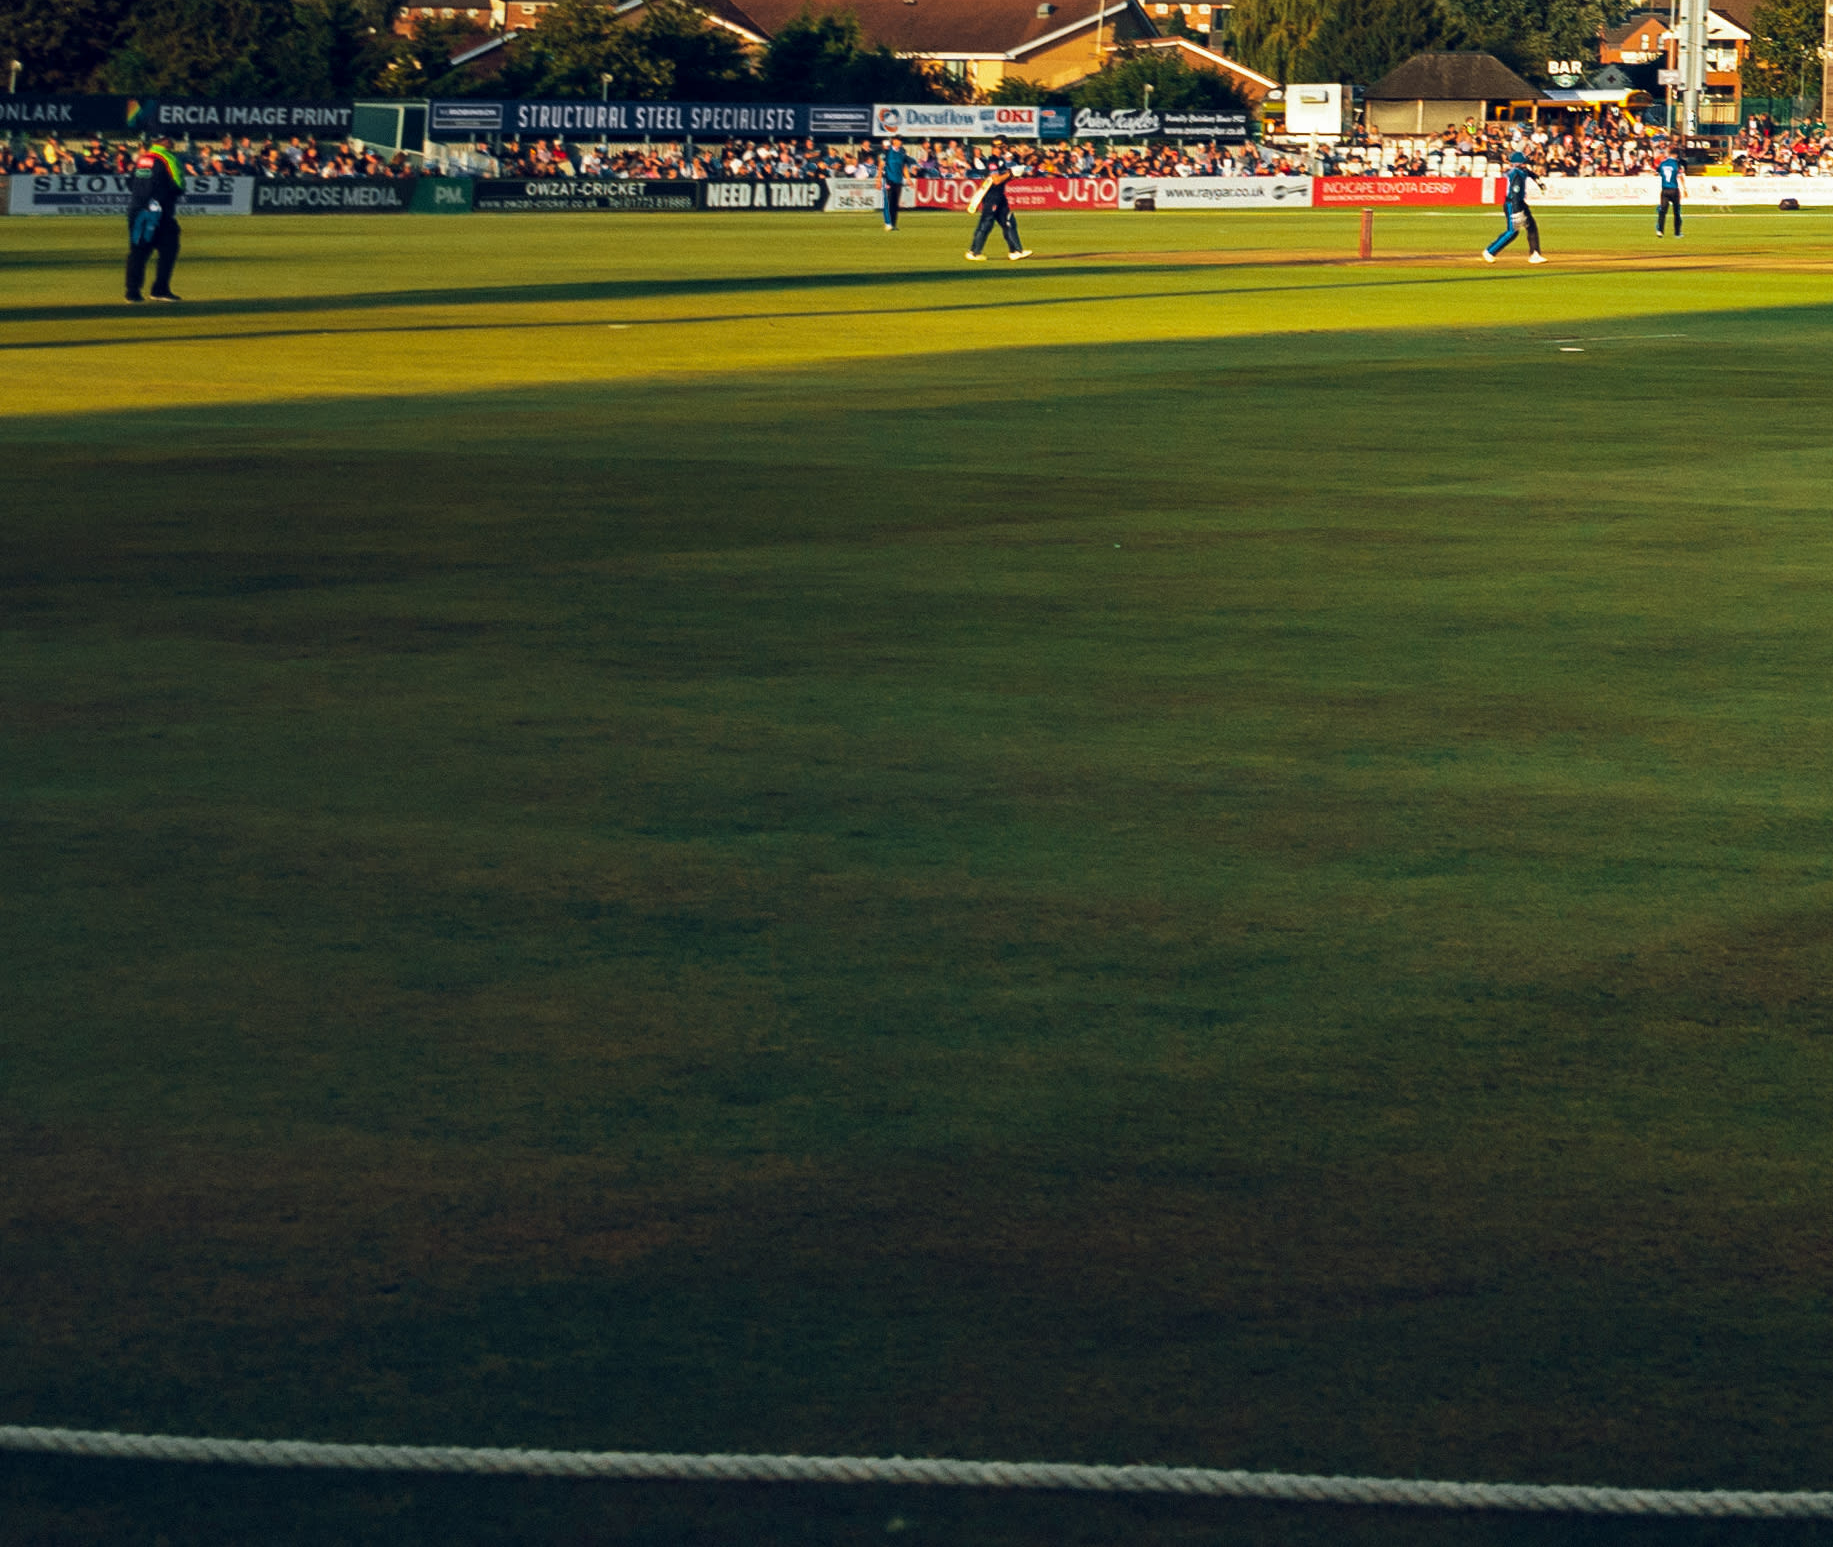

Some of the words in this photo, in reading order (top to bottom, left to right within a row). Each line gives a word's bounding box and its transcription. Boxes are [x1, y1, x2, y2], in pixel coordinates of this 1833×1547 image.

[1548, 60, 1582, 74] BAR
[160, 105, 221, 124] ERCIA
[225, 106, 287, 125] IMAGE
[292, 108, 352, 126] PRINT
[518, 105, 628, 129] STRUCTURAL
[635, 106, 683, 129] STEEL
[690, 107, 796, 131] SPECIALISTS
[905, 108, 975, 125] Docuflow
[996, 108, 1034, 124] OKI
[259, 186, 341, 206] PURPOSE
[526, 183, 647, 196] OWZAT-CRICKET
[706, 183, 751, 207] NEED
[753, 183, 767, 207] A
[770, 183, 821, 207] TAXI?
[1323, 182, 1374, 194] INCHCAPE
[1377, 182, 1418, 194] TOYOTA
[1419, 183, 1456, 195] DERBY
